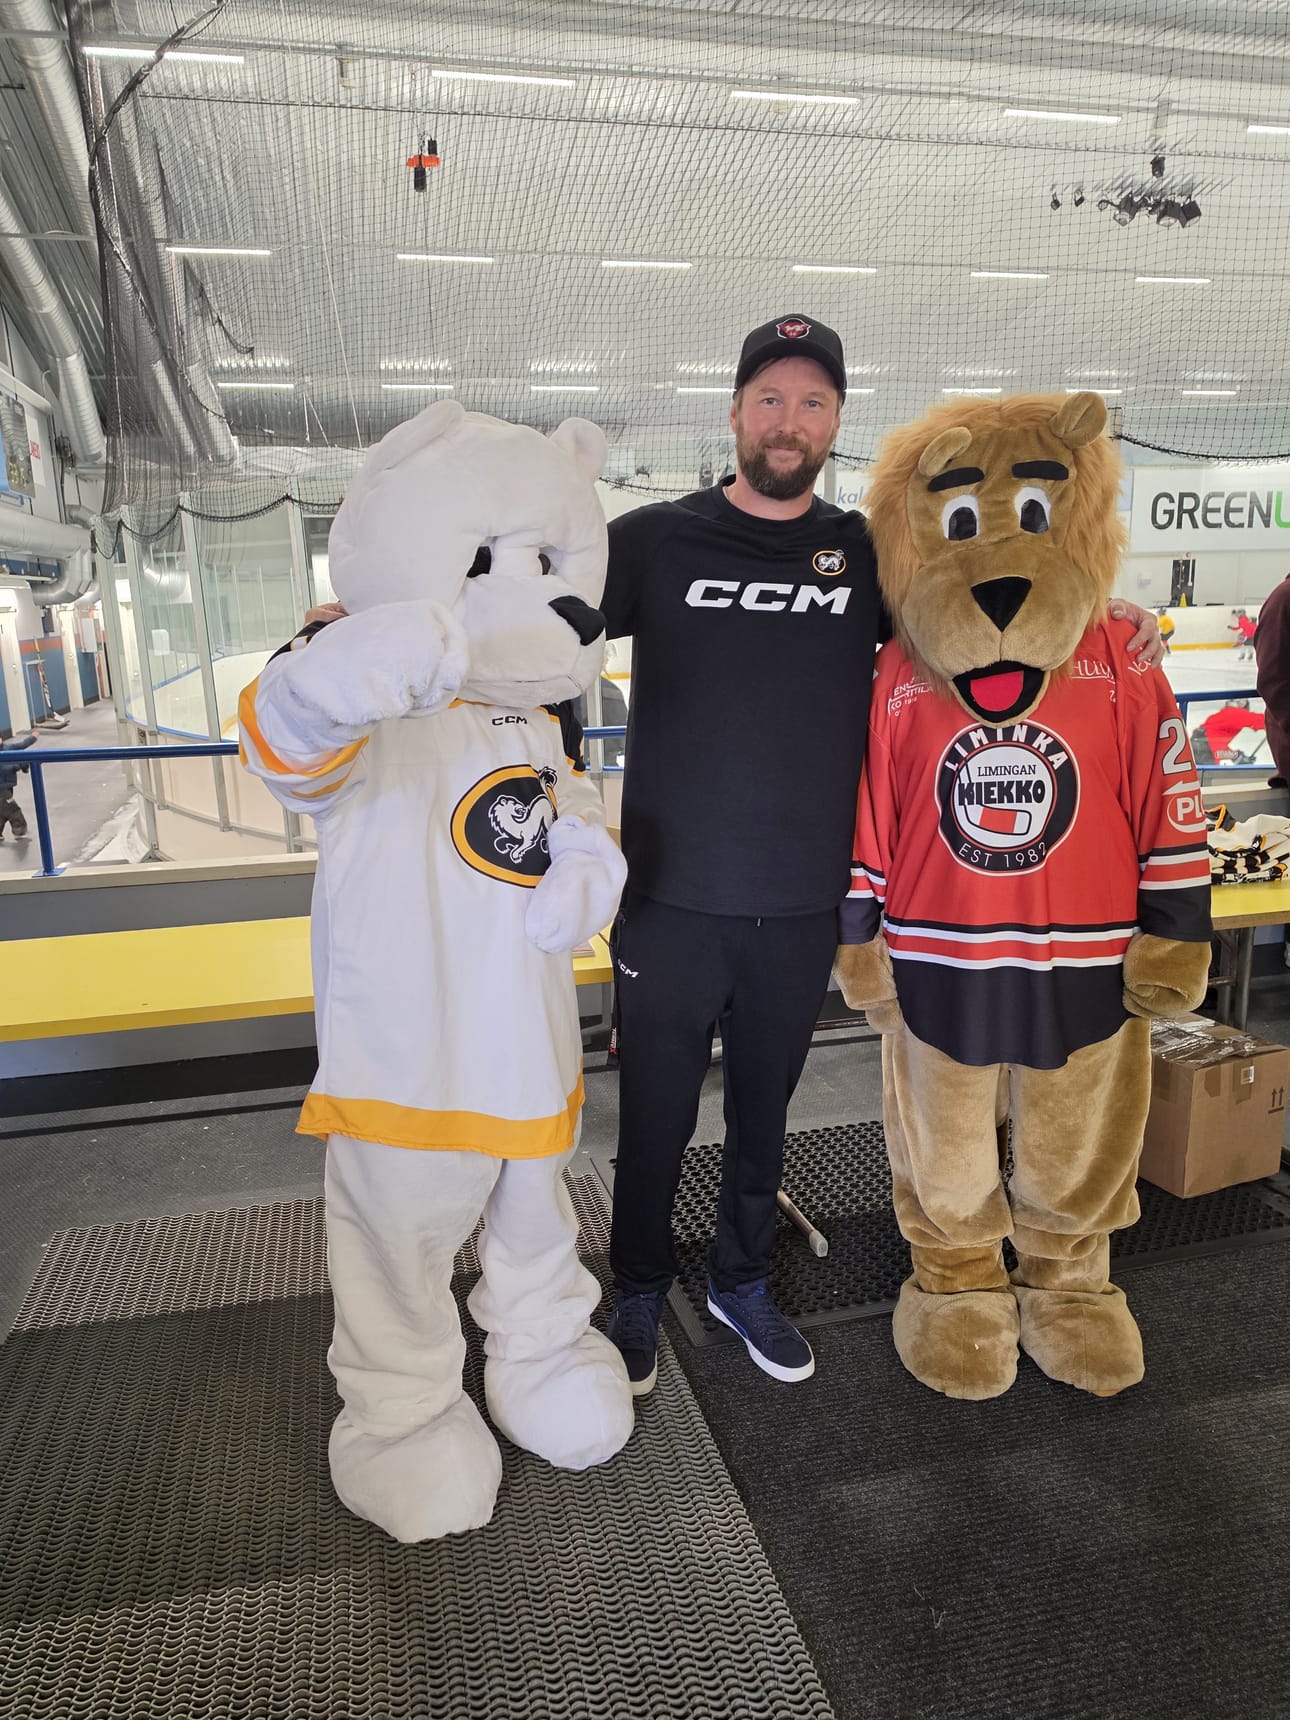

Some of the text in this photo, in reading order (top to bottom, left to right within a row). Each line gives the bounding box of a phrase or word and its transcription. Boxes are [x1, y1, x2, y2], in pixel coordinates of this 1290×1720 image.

[685, 579, 852, 615] CCM
[491, 715, 528, 726] CCM
[944, 724, 1069, 772] LIMINKA
[977, 764, 1037, 777] LIMINGAN
[958, 779, 1046, 806] KIEKKO
[958, 842, 993, 867] EST
